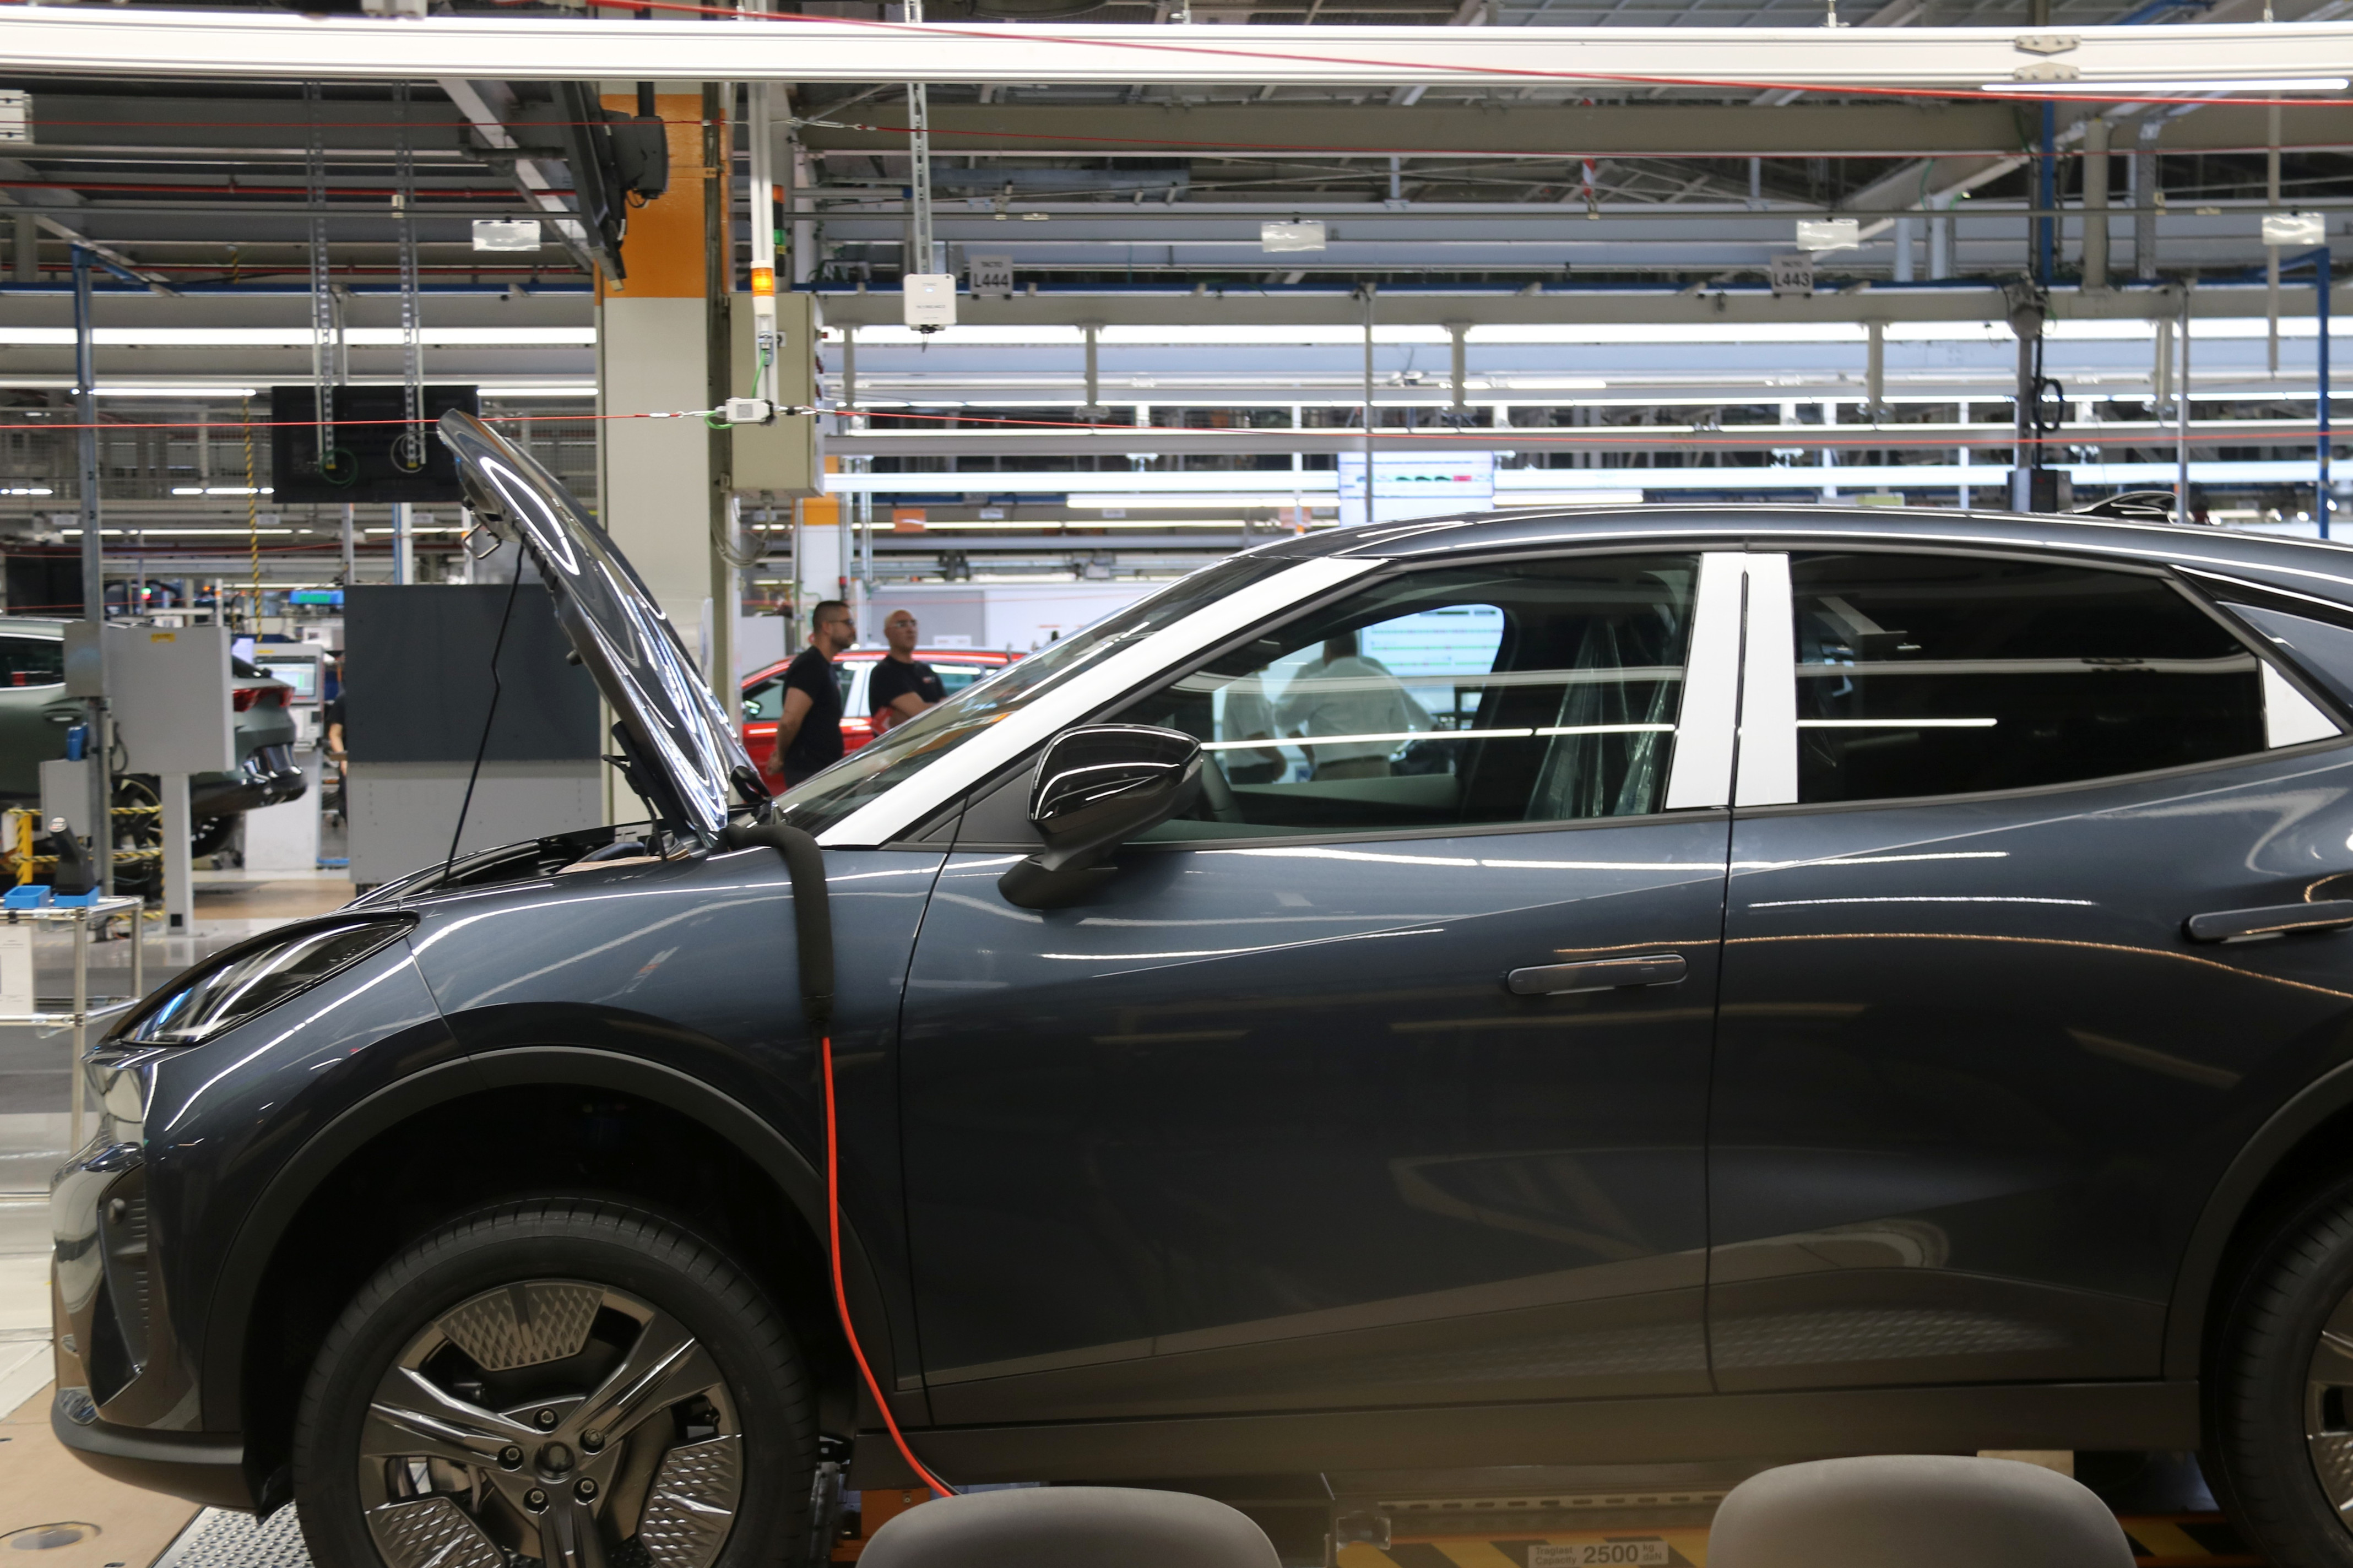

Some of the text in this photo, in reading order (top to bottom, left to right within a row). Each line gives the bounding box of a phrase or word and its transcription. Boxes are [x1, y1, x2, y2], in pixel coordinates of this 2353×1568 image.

[974, 273, 1009, 287] L444
[1774, 272, 1810, 286] L443
[1536, 1546, 1573, 1556] Traglast
[1584, 1544, 1654, 1564] 2500 kg
[1535, 1552, 1662, 1566] Capacity daN
